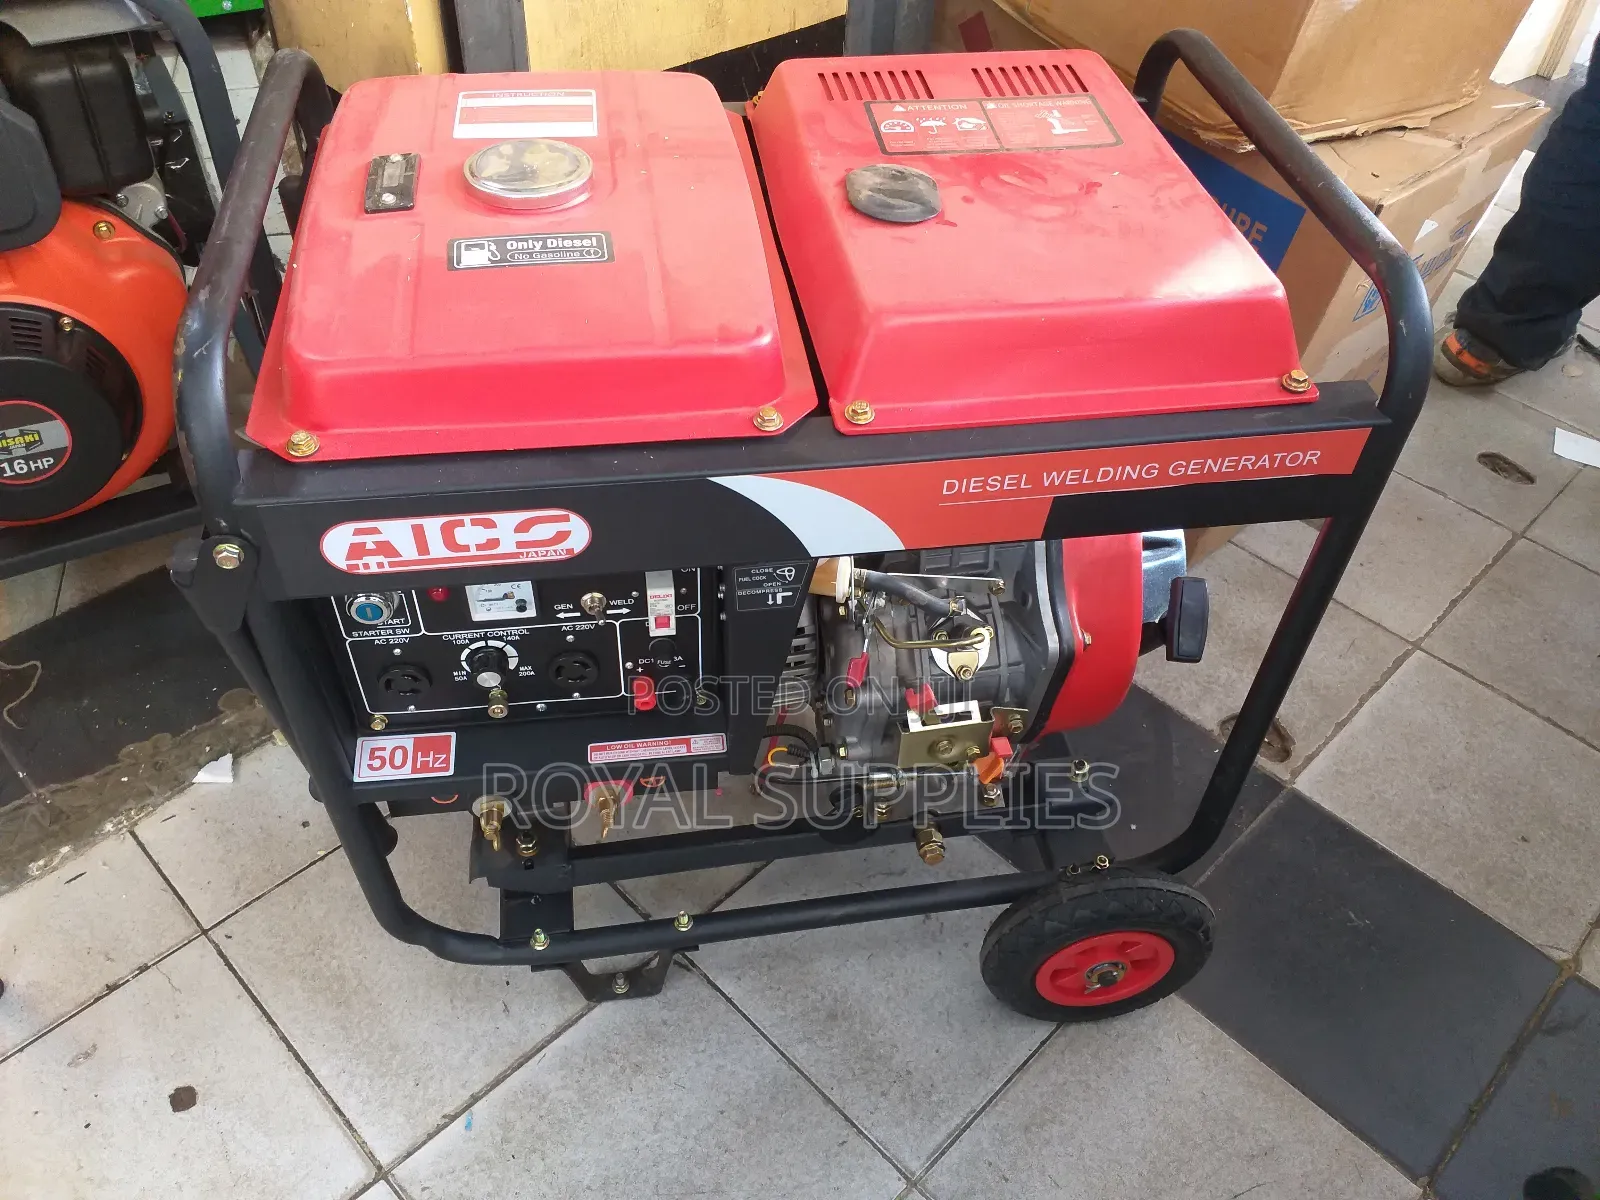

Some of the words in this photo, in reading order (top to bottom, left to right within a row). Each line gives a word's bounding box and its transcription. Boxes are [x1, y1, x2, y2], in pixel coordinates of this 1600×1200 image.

[907, 103, 968, 112] ATTENTION
[506, 239, 544, 251] Only
[546, 236, 598, 249] Diesel
[514, 251, 530, 261] No
[533, 249, 581, 260] Gasoline
[0, 458, 28, 477] 16
[29, 457, 55, 472] HP
[942, 474, 1033, 496] DIESEL
[1041, 463, 1160, 488] WELDING
[1168, 450, 1322, 477] GENERATOR
[519, 548, 567, 560] JAPAN
[737, 588, 783, 596] DECOMPRESS
[553, 603, 574, 611] GEN
[609, 598, 635, 606] WELD
[677, 603, 697, 611] OFF
[352, 629, 394, 637] STARTER
[575, 623, 596, 631] 220V
[442, 631, 486, 641] CURRENT
[486, 628, 530, 637] CONTROL
[636, 740, 672, 748] WARNING!
[366, 745, 409, 772] 50
[416, 750, 447, 769] Hz
